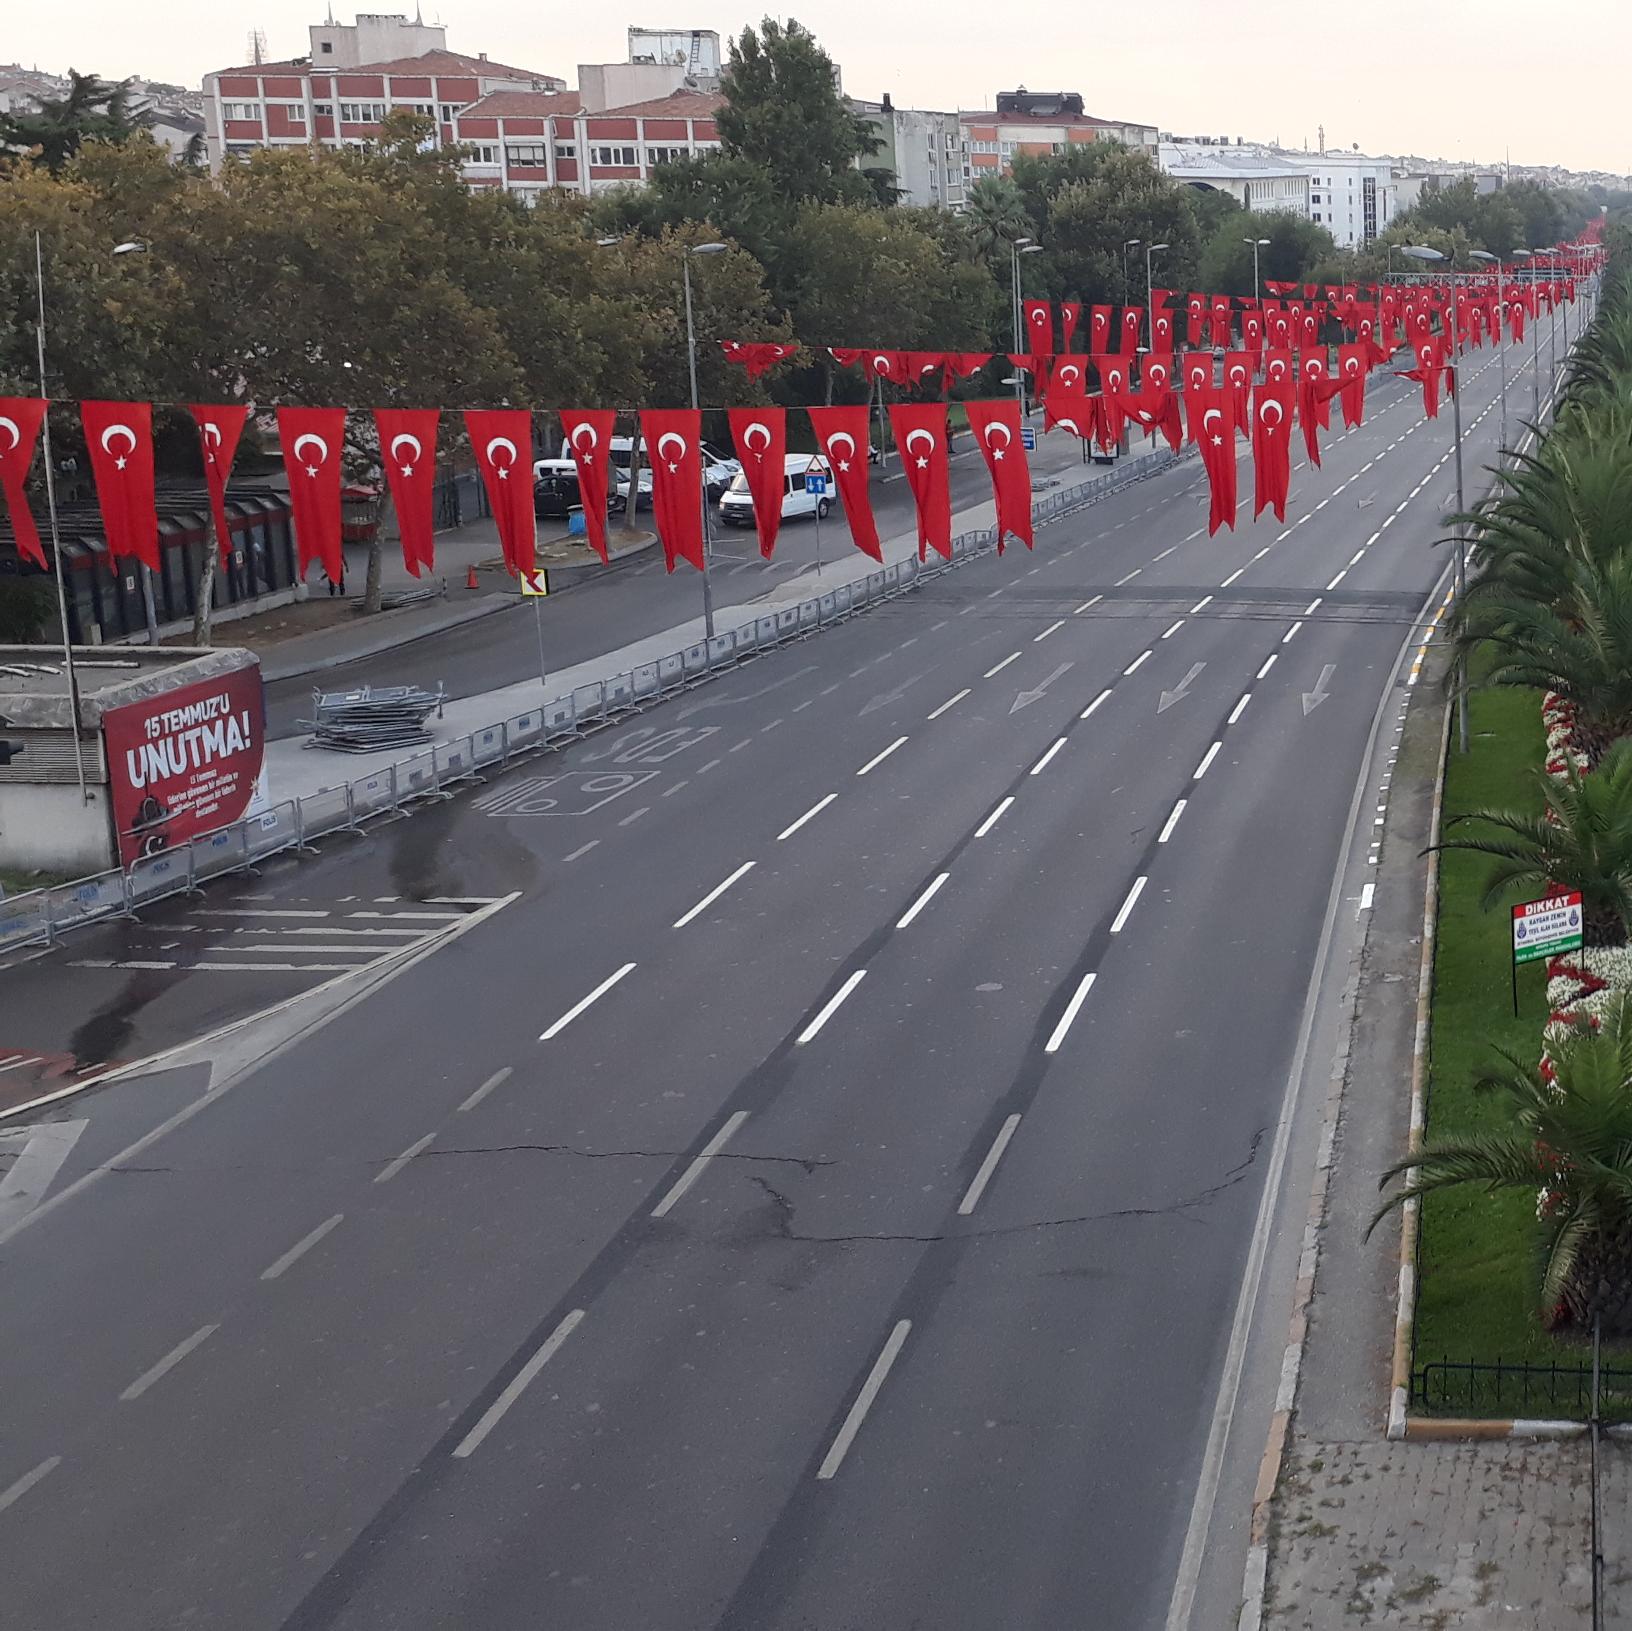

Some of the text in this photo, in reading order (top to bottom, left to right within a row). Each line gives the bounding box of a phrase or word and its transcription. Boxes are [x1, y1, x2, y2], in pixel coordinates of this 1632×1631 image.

[144, 692, 230, 740] 15 TEMMUZ'U
[126, 710, 251, 789] UNUTMA!
